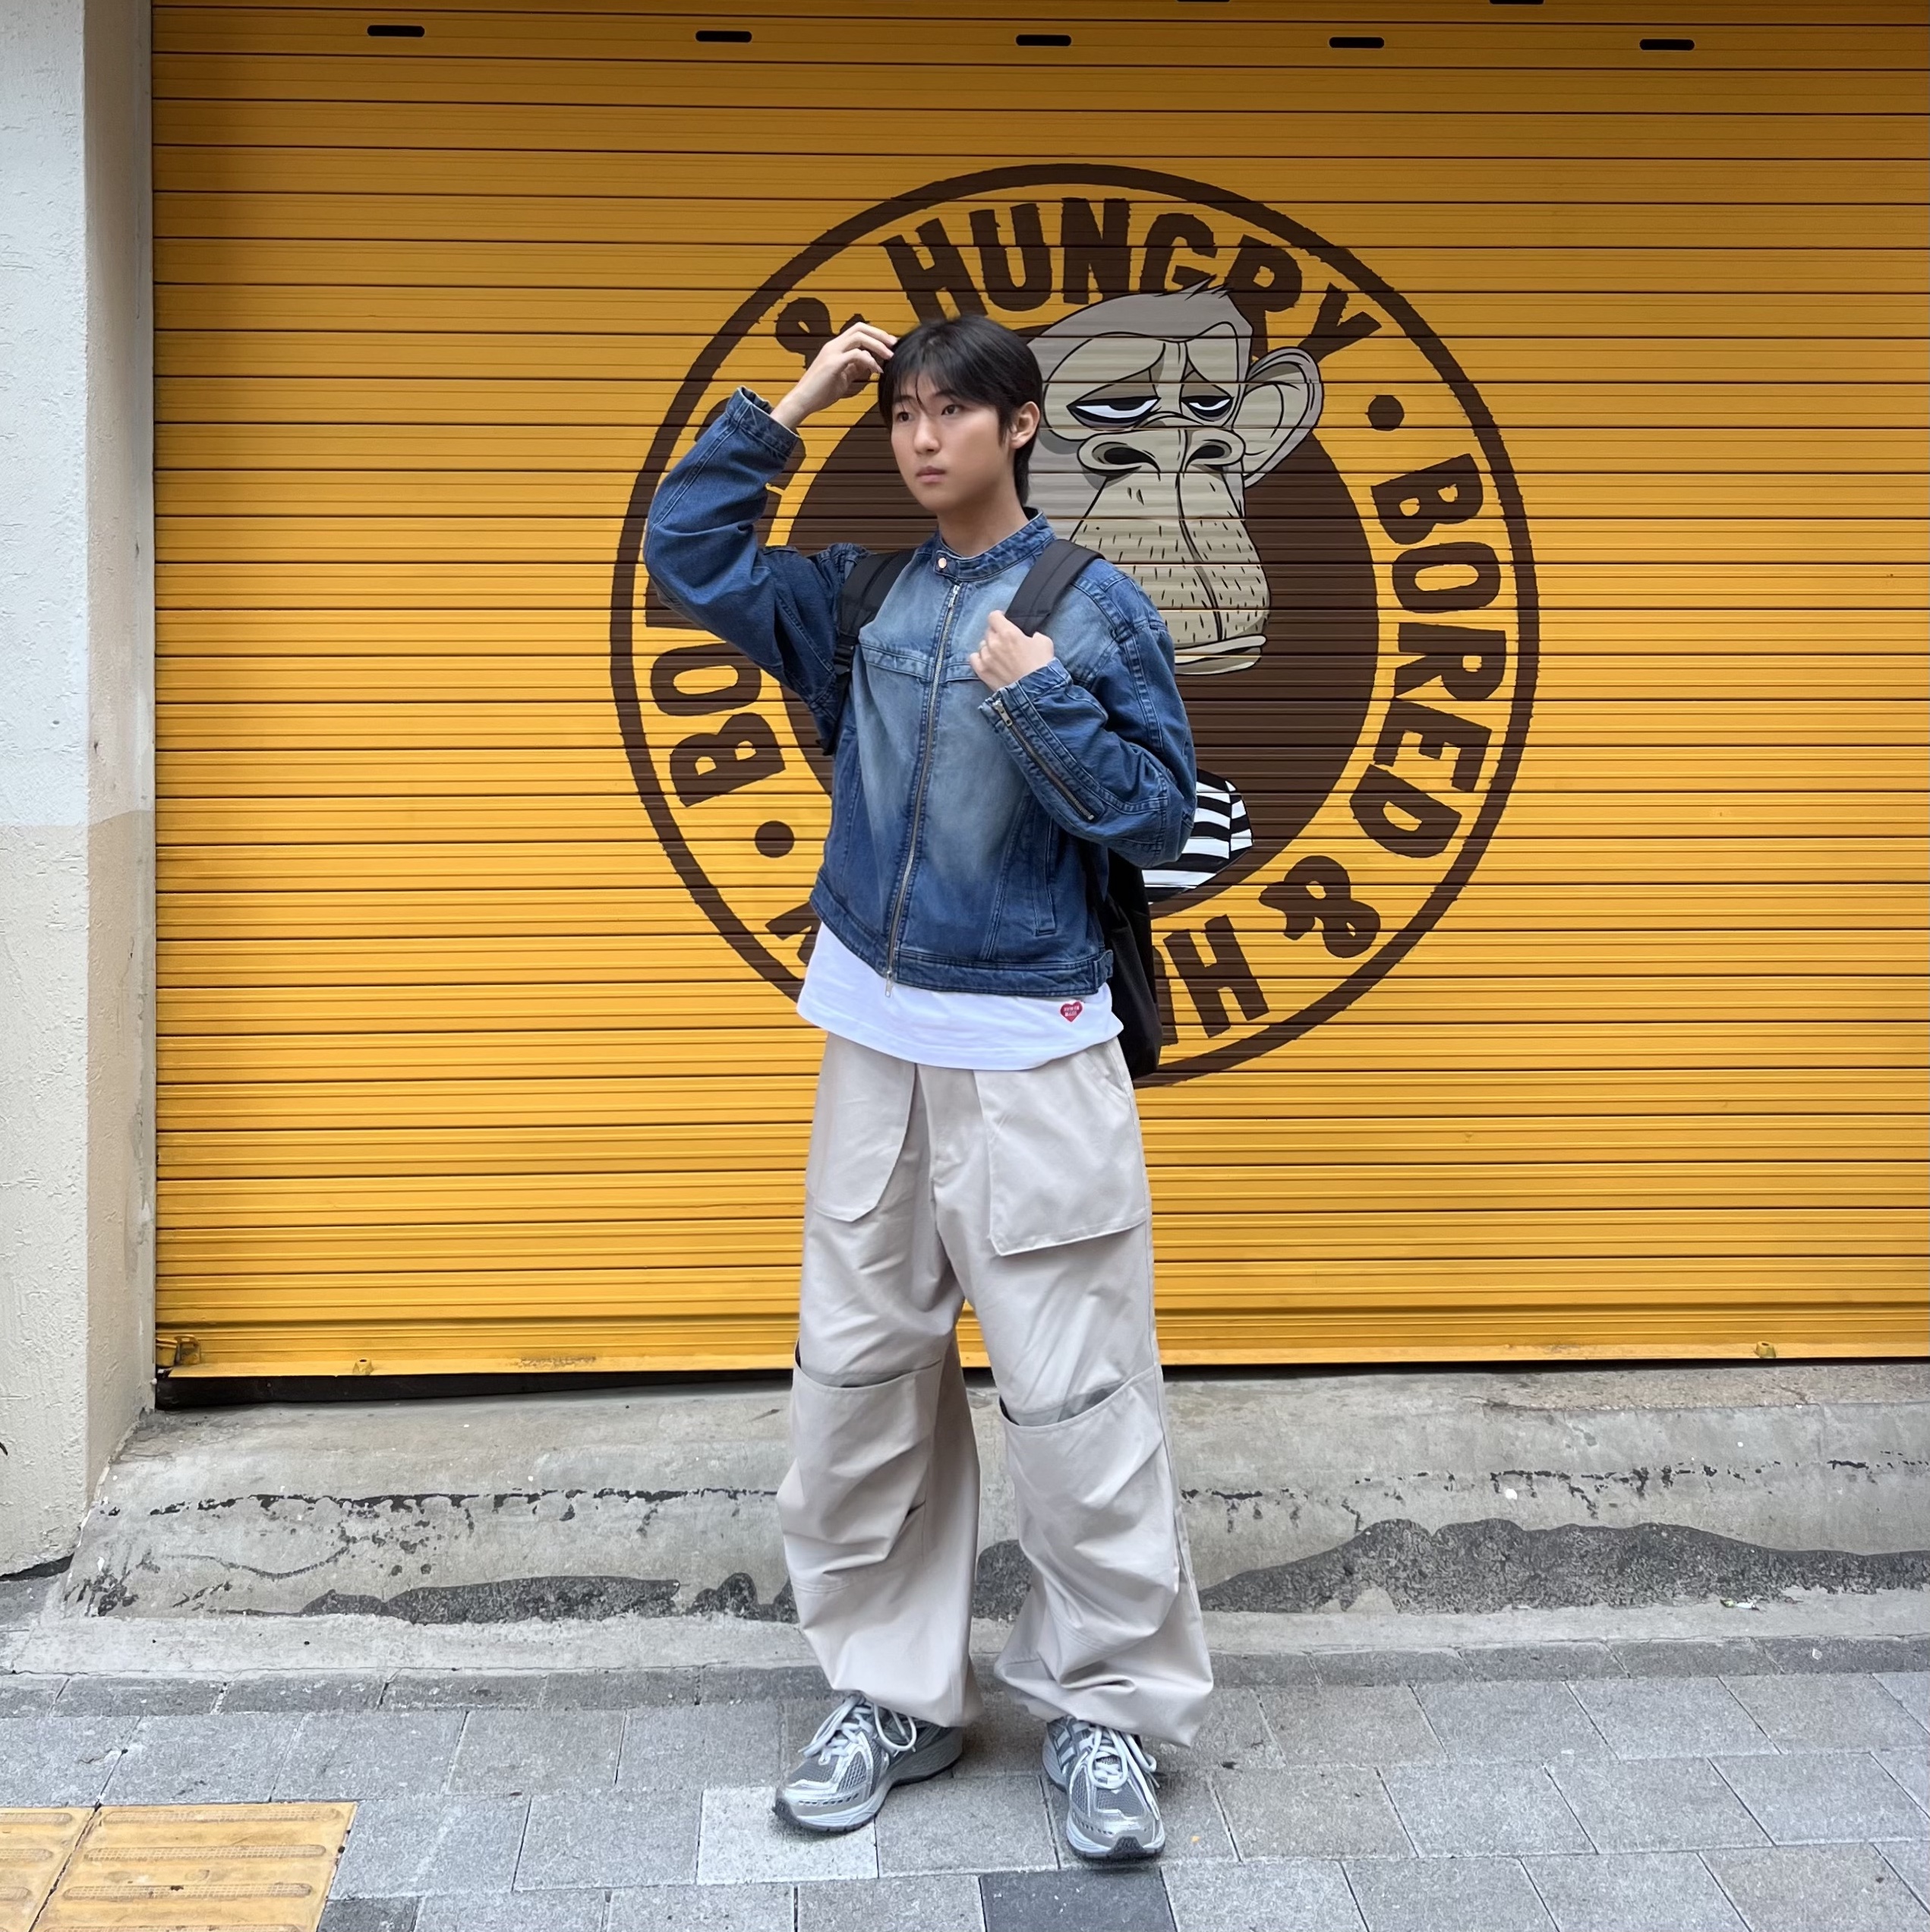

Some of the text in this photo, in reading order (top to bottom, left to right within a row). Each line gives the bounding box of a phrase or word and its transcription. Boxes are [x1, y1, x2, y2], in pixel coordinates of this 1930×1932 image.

[878, 197, 1383, 364] HUNGRY
[1258, 453, 1506, 958] BORED &
